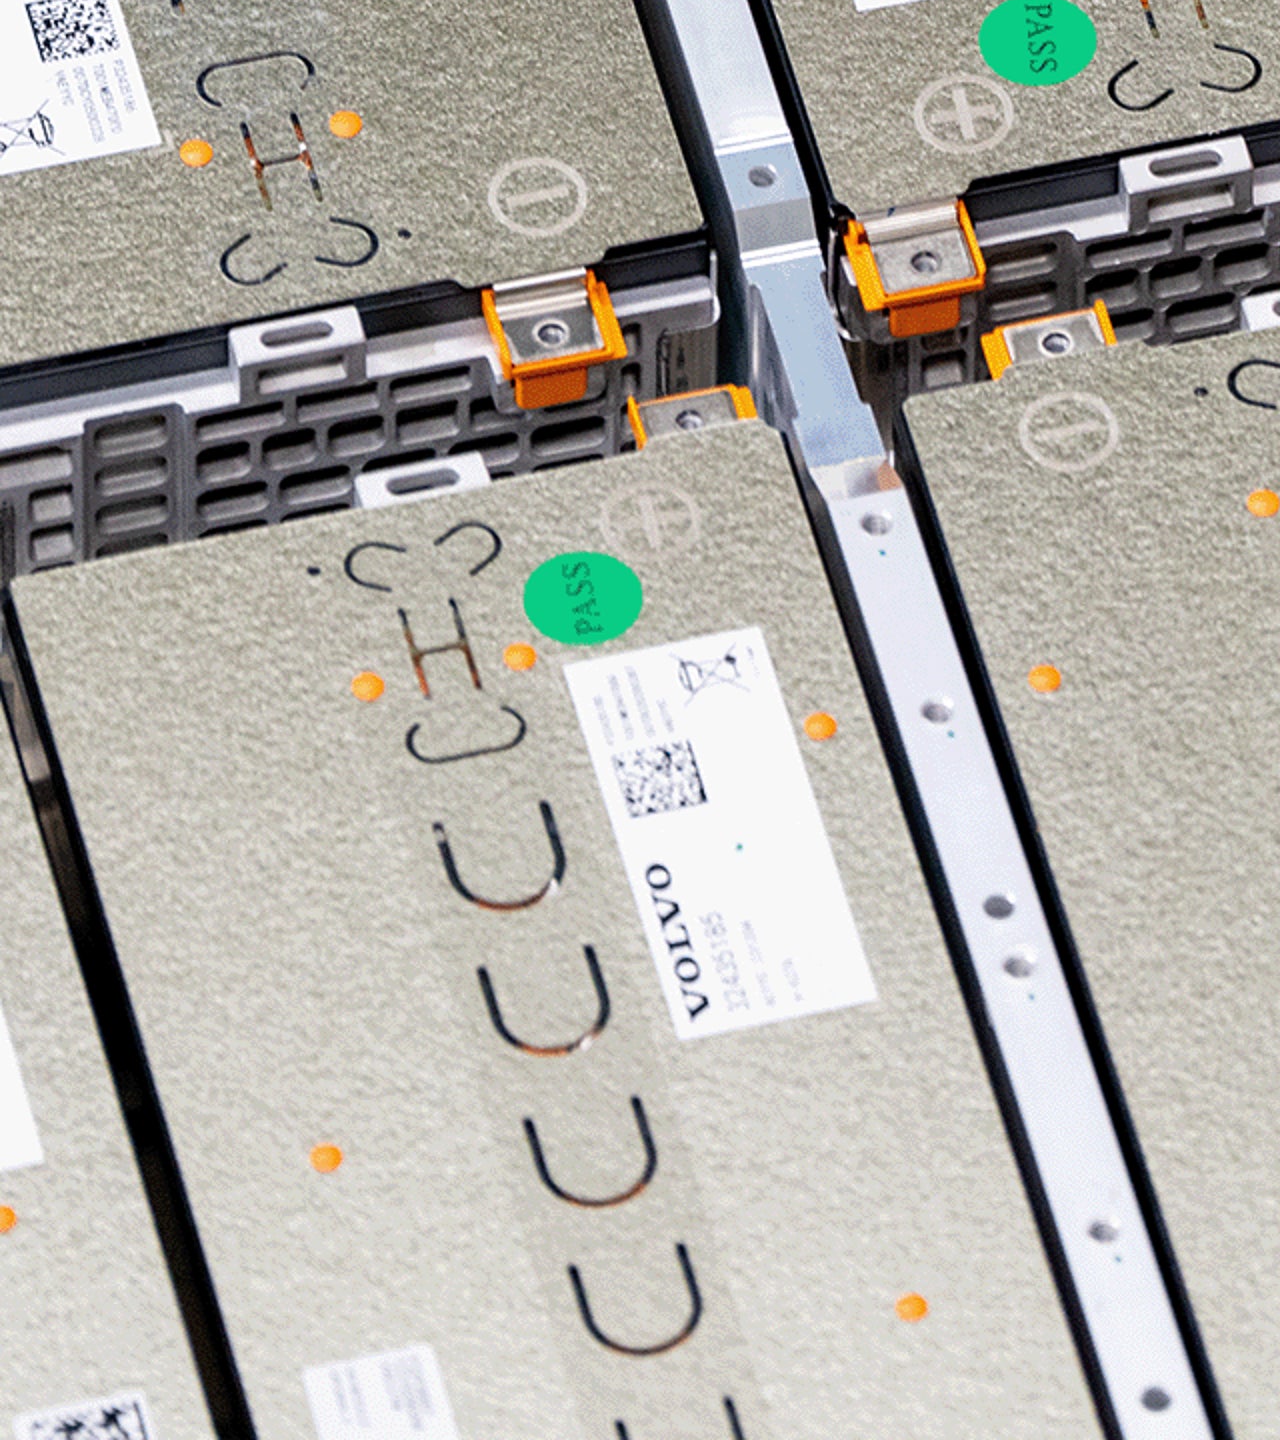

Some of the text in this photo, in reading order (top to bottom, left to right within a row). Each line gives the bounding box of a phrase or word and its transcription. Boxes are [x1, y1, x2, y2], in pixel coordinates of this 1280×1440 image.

[1025, 2, 1058, 75] PASS
[561, 561, 604, 636] PASS
[646, 864, 709, 1020] VOLVO
